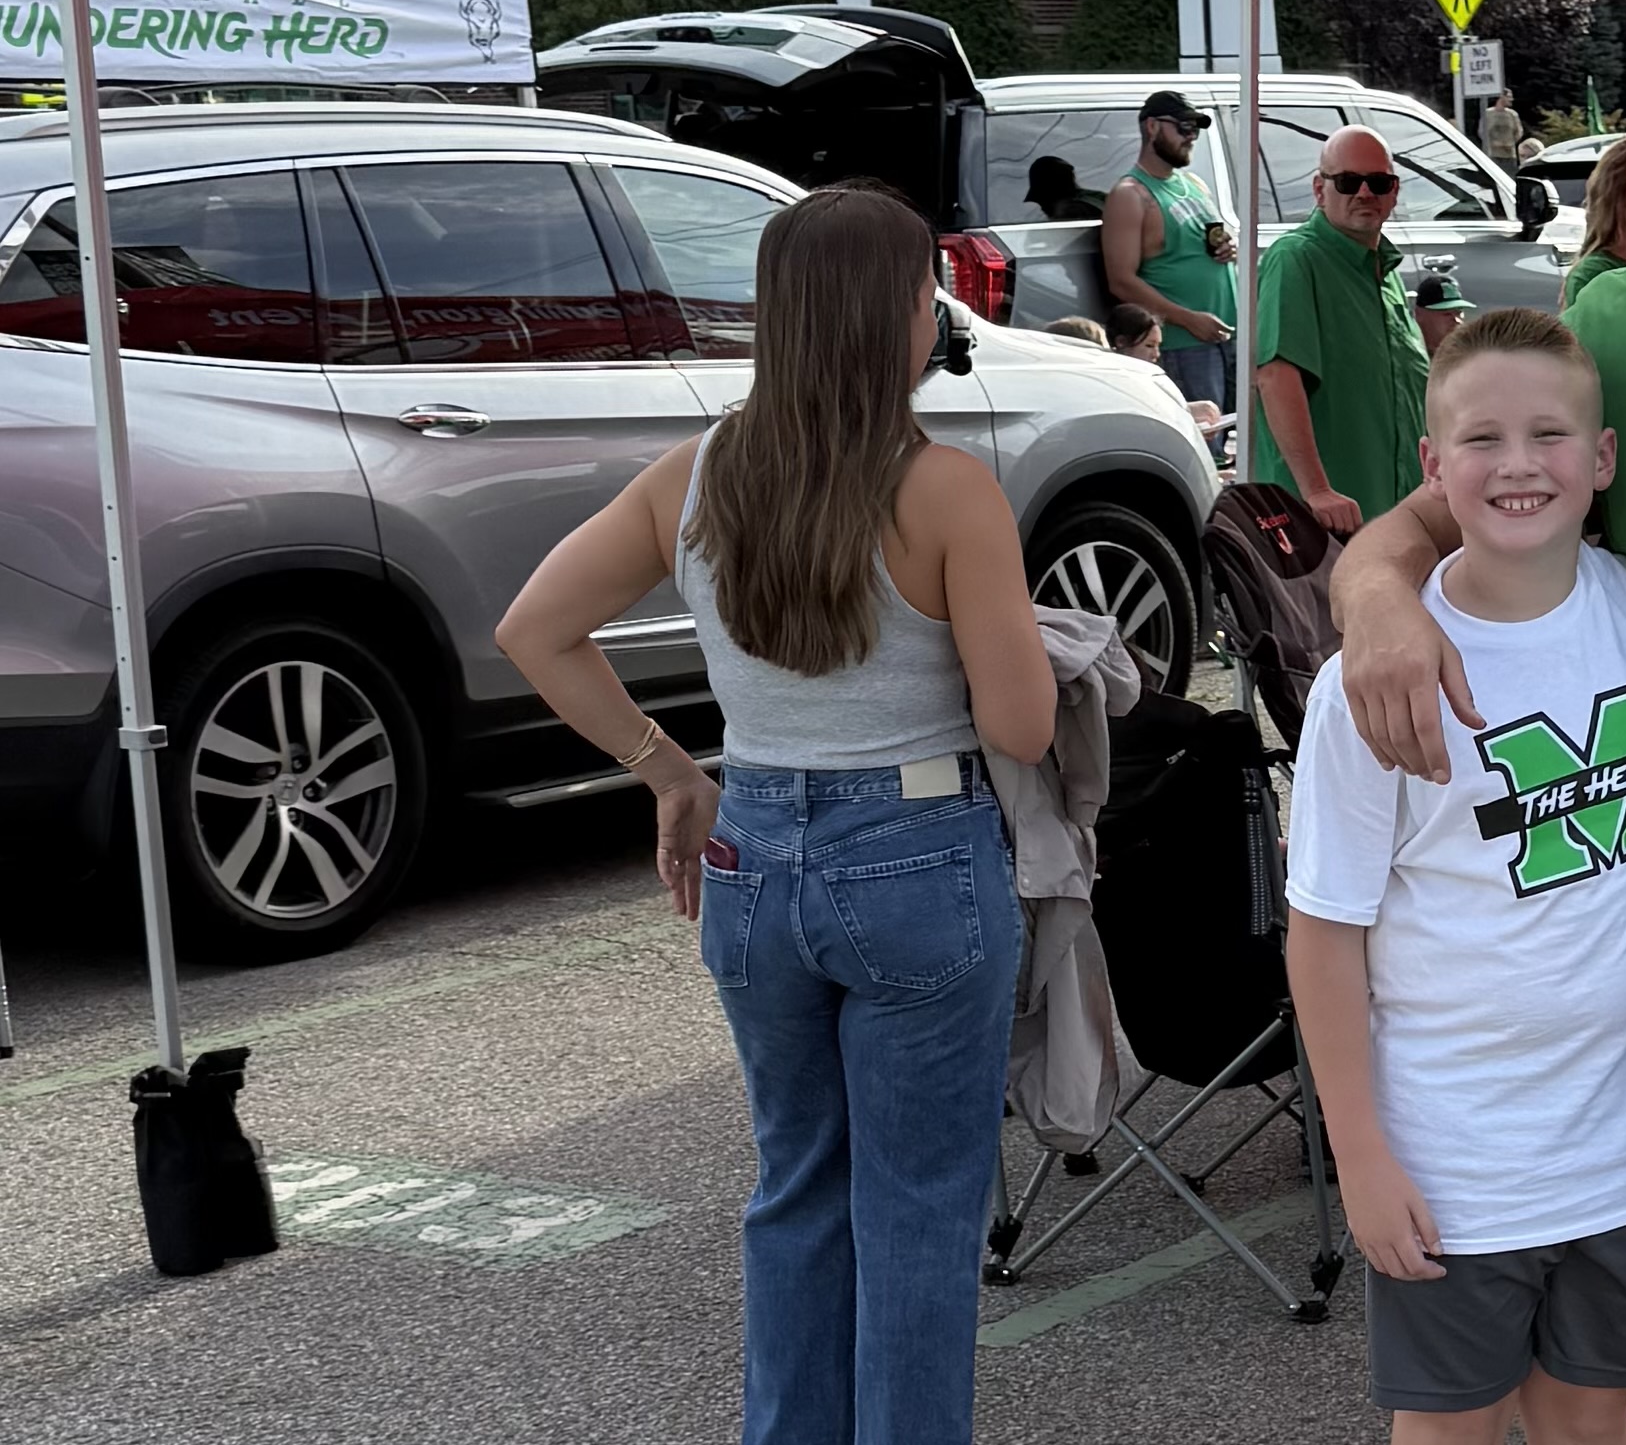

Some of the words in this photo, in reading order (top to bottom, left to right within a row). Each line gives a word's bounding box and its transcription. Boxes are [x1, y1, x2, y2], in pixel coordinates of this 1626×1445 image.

[0, 1, 254, 60] UNDERING
[263, 11, 391, 63] HERD
[1472, 46, 1489, 57] NO
[1470, 59, 1492, 72] LEFT
[1470, 73, 1495, 85] TURN
[1517, 780, 1578, 825] THE
